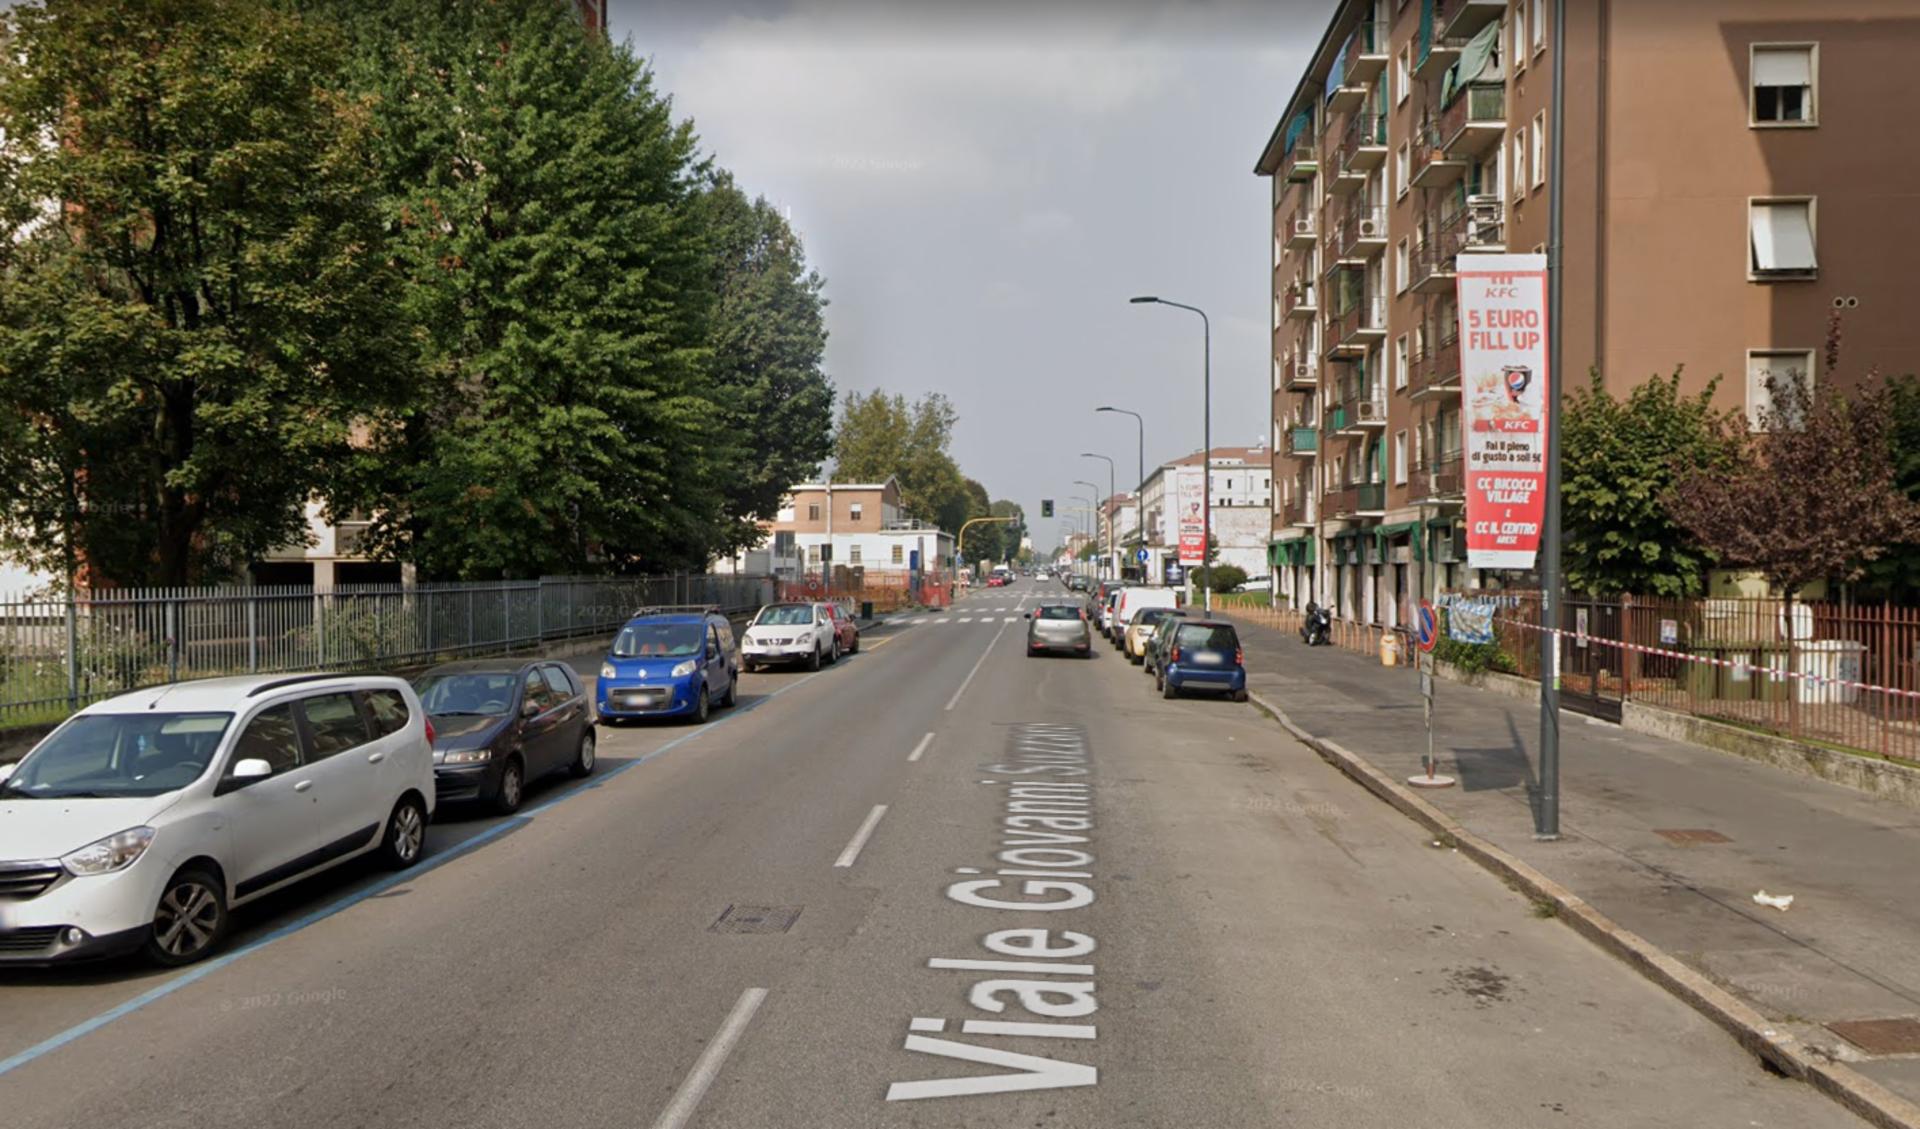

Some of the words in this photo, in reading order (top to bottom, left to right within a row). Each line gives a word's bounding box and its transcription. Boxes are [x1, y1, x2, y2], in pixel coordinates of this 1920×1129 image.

[1485, 287, 1518, 298] KFC
[1468, 310, 1480, 328] 5
[1486, 310, 1538, 328] EURO
[1469, 332, 1509, 350] FILL
[1513, 332, 1540, 350] UP
[1504, 420, 1530, 430] KFC
[1485, 441, 1498, 450] Fai
[1507, 442, 1529, 453] pieno
[1472, 453, 1481, 461] di
[1482, 454, 1508, 464] gusto
[1516, 453, 1530, 462] soli
[1477, 478, 1492, 490] CC
[1494, 478, 1537, 491] BICOCCA
[1487, 491, 1530, 504] VILLAGE
[1475, 522, 1488, 533] CC
[1502, 523, 1537, 535] CENTRO
[946, 781, 1095, 912] Giovanni
[886, 928, 1098, 1101] Viale
